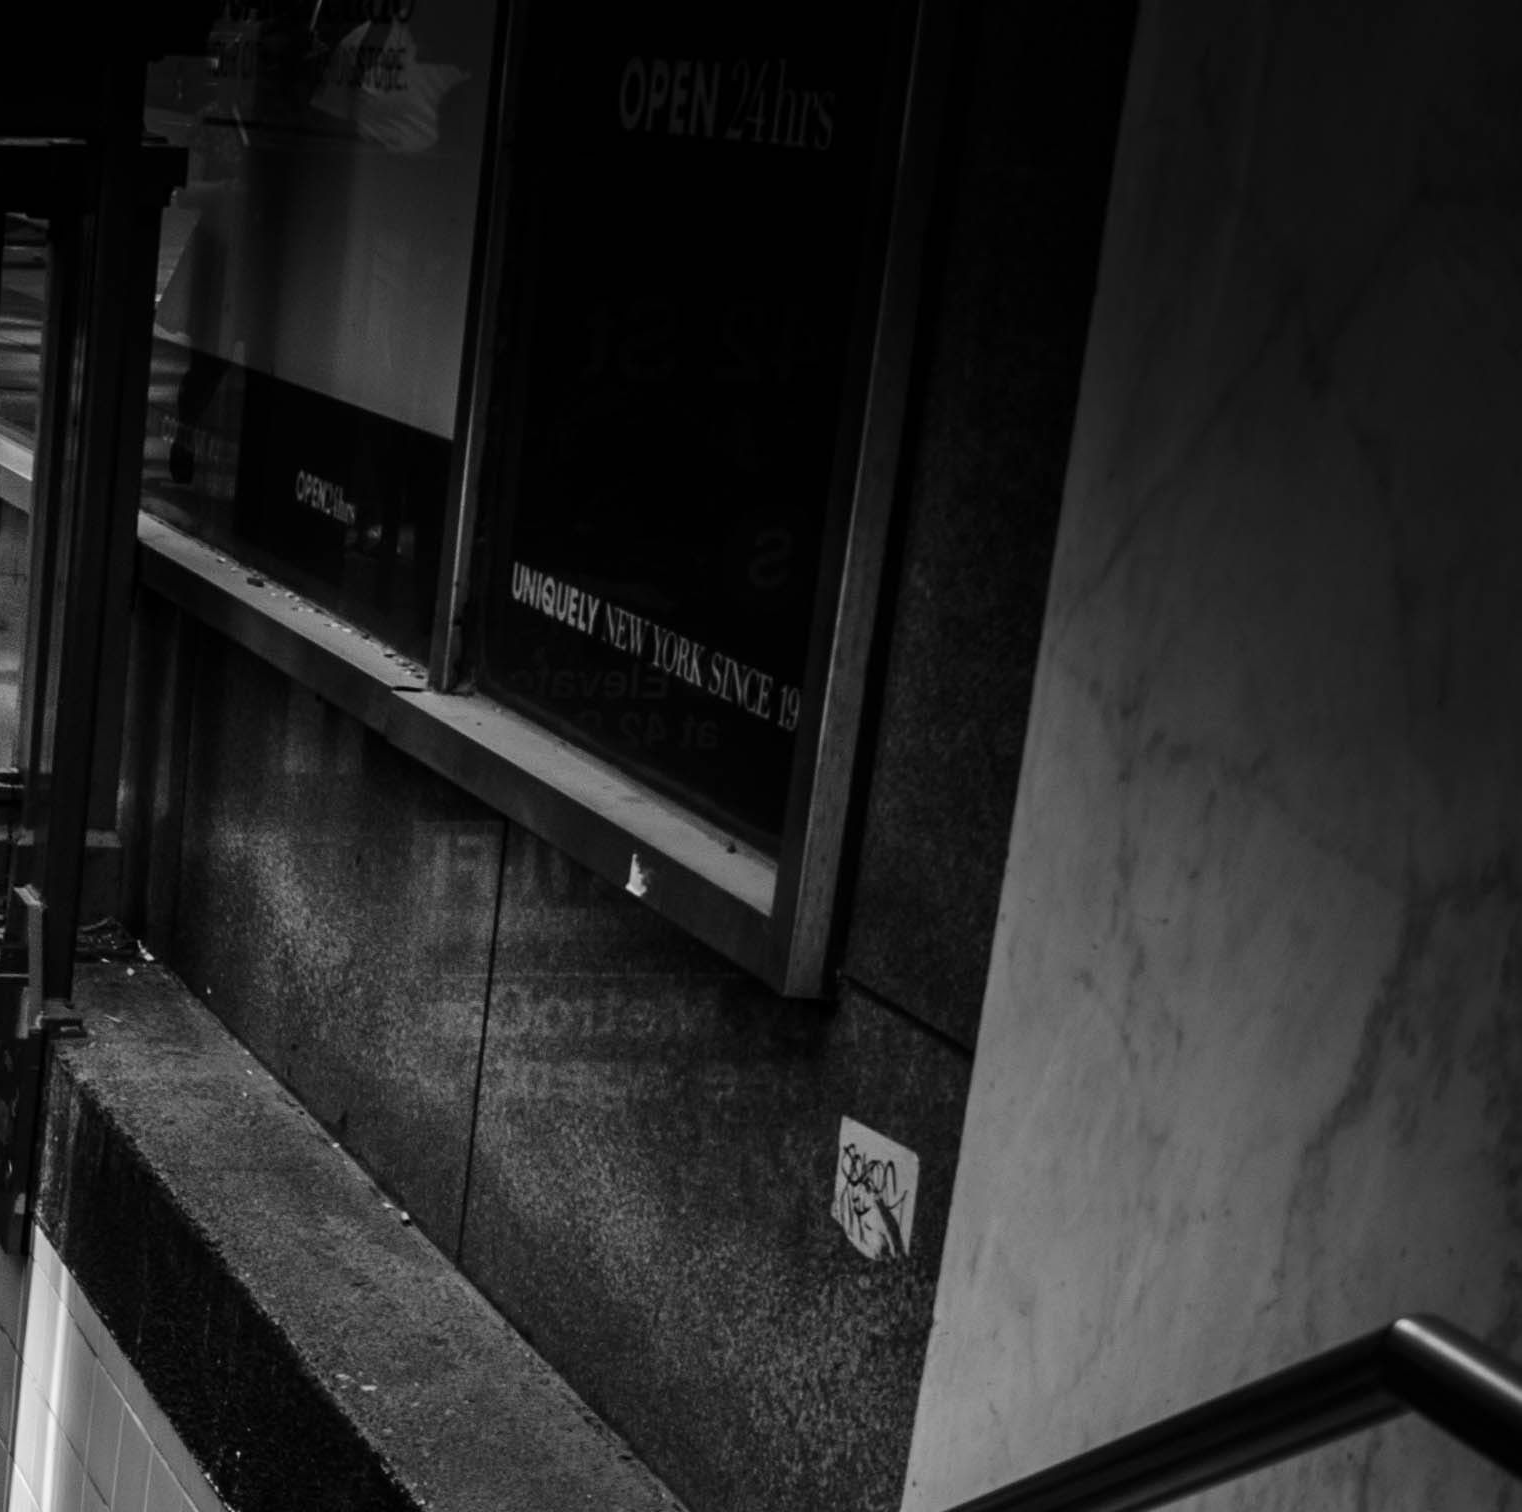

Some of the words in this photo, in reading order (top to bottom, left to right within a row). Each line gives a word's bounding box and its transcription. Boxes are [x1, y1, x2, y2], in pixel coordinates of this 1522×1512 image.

[618, 55, 722, 139] OPEN
[512, 561, 601, 636] UNIQUELY
[603, 601, 650, 657] NEW
[652, 624, 706, 688] YORK
[707, 651, 773, 721] SINCE
